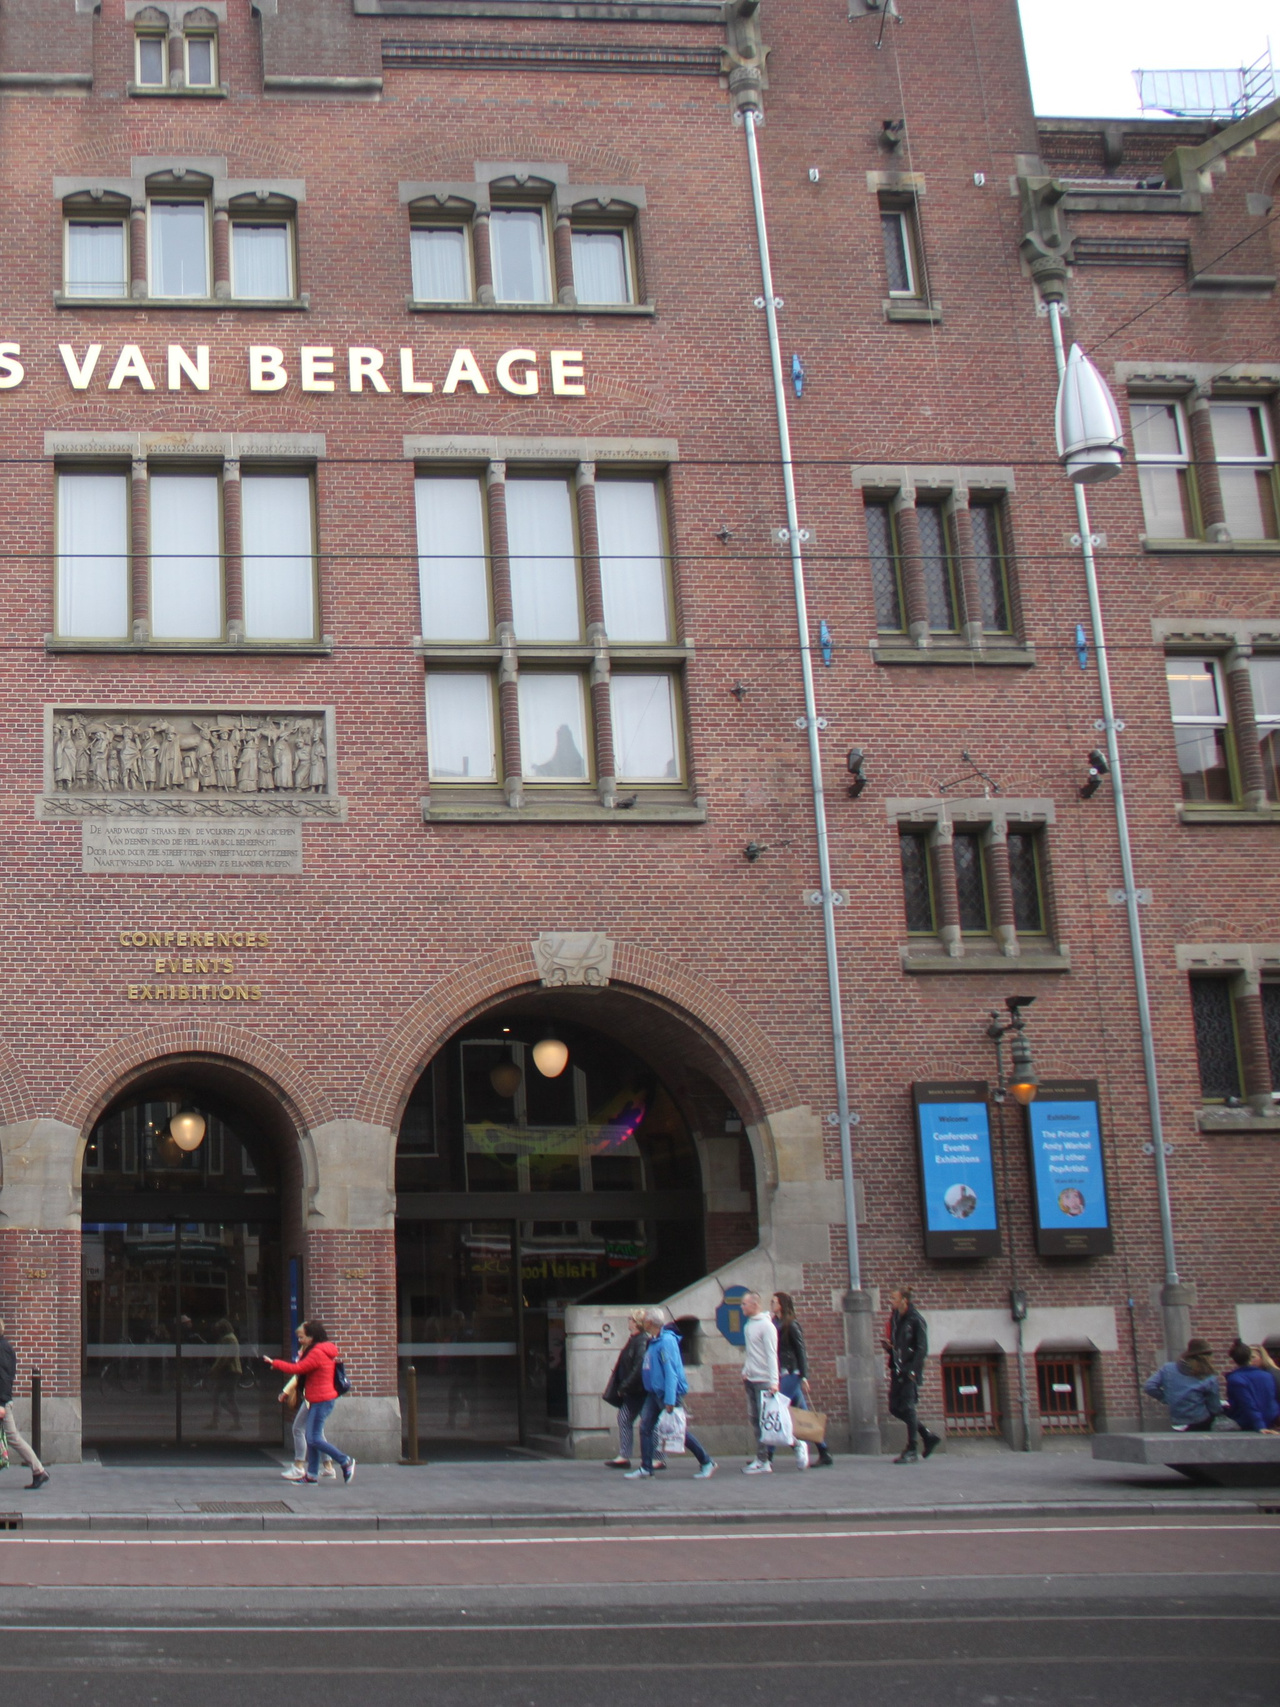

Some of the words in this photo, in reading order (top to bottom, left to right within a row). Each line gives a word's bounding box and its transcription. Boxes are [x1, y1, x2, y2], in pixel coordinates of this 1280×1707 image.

[59, 343, 210, 391] VAN
[249, 345, 586, 396] BERLAGE
[105, 827, 122, 835] AARD
[123, 827, 148, 835] WORDT
[151, 827, 176, 836] STRAKS
[196, 828, 204, 836] DE
[254, 828, 265, 836] ALS
[267, 828, 296, 837] GROEPEN
[107, 836, 123, 845] VAN
[151, 838, 170, 846] BOND
[172, 838, 182, 846] DIE
[184, 838, 199, 846] HEEL
[201, 839, 219, 847] HAAR
[220, 839, 235, 847] BOL
[86, 845, 107, 856] DOOR
[127, 849, 147, 857] DOOR
[178, 860, 216, 868] WAARHEEN
[219, 860, 230, 868] ZE
[231, 860, 264, 868] ELKANDER
[119, 931, 270, 947] CONFERENCES
[154, 958, 235, 974] EVENTS
[127, 985, 262, 1001] EXHIBITIONS
[933, 1132, 979, 1141] Conference
[1041, 1130, 1057, 1138] The
[1057, 1130, 1080, 1138] Prints
[1080, 1130, 1091, 1138] of
[943, 1143, 971, 1152] Events
[1042, 1142, 1063, 1151] Andy
[1063, 1141, 1092, 1150] Warhol
[935, 1154, 980, 1164] Exhibitions
[1049, 1153, 1064, 1161] and
[1065, 1153, 1086, 1161] other
